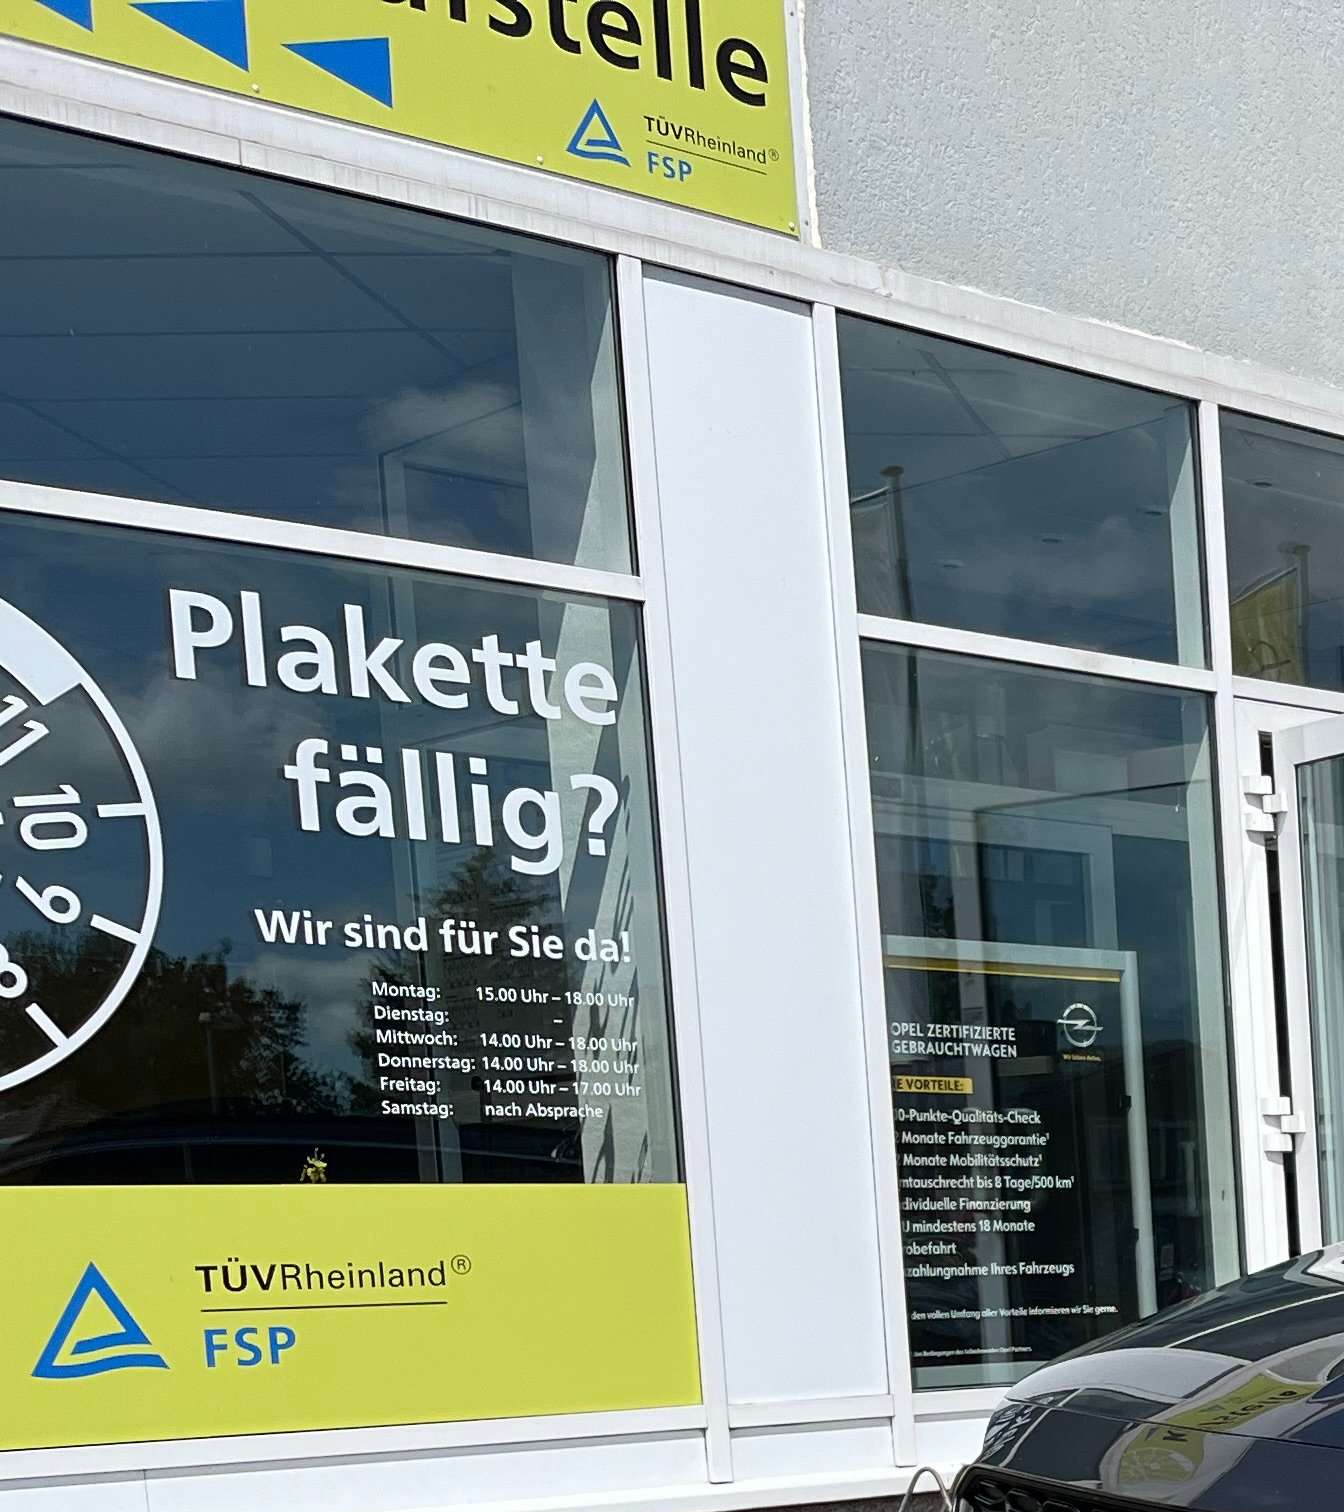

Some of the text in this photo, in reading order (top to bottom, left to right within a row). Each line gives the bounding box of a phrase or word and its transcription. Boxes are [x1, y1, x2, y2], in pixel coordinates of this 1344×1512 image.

[648, 152, 692, 182] FSP
[169, 588, 619, 726] Plakette
[13, 784, 88, 850] 10
[284, 738, 620, 876] fällig?
[254, 908, 633, 964] Wir sind für Sie da!
[371, 981, 442, 1000] Montag:
[476, 986, 518, 1002] 15.00
[520, 987, 549, 1004] Uhr
[564, 991, 605, 1006] 18.00
[607, 993, 635, 1008] Uhr
[374, 1005, 450, 1025] Dienstag:
[376, 1029, 458, 1047] Mittwoch:
[480, 1033, 522, 1048] 14.00
[524, 1034, 553, 1050] Uhr
[568, 1037, 608, 1051] 18.00
[610, 1038, 638, 1053] Uhr
[891, 1022, 1017, 1041] OPEL ZERTIFIZIERTE
[892, 1040, 1018, 1058] GEBRAUCHTWAGEN
[378, 1052, 476, 1072] Donnerstag:
[482, 1056, 524, 1072] 14.00
[526, 1057, 555, 1073] Uhr
[570, 1059, 610, 1075] 18.00
[613, 1060, 641, 1075] Uhr
[379, 1076, 442, 1095] Freitag:
[484, 1079, 525, 1095] 14.00
[528, 1080, 557, 1095] Uhr
[572, 1082, 612, 1097] 17.00
[614, 1083, 642, 1098] Uhr
[905, 1078, 964, 1092] VORTEILE:
[381, 1100, 604, 1120] Samstag: nach Absprache
[901, 1131, 946, 1145] Monate
[903, 1153, 948, 1167] Monate
[976, 1175, 993, 1189] bis
[994, 1176, 1002, 1188] 8
[959, 1197, 1032, 1213] Finanzierung
[912, 1219, 977, 1232] mindestens
[978, 1219, 991, 1232] 18
[992, 1219, 1036, 1232] Monate
[990, 1262, 1018, 1276] Ihres
[1019, 1261, 1076, 1279] Fahrzeugs
[203, 1326, 297, 1368] FSP
